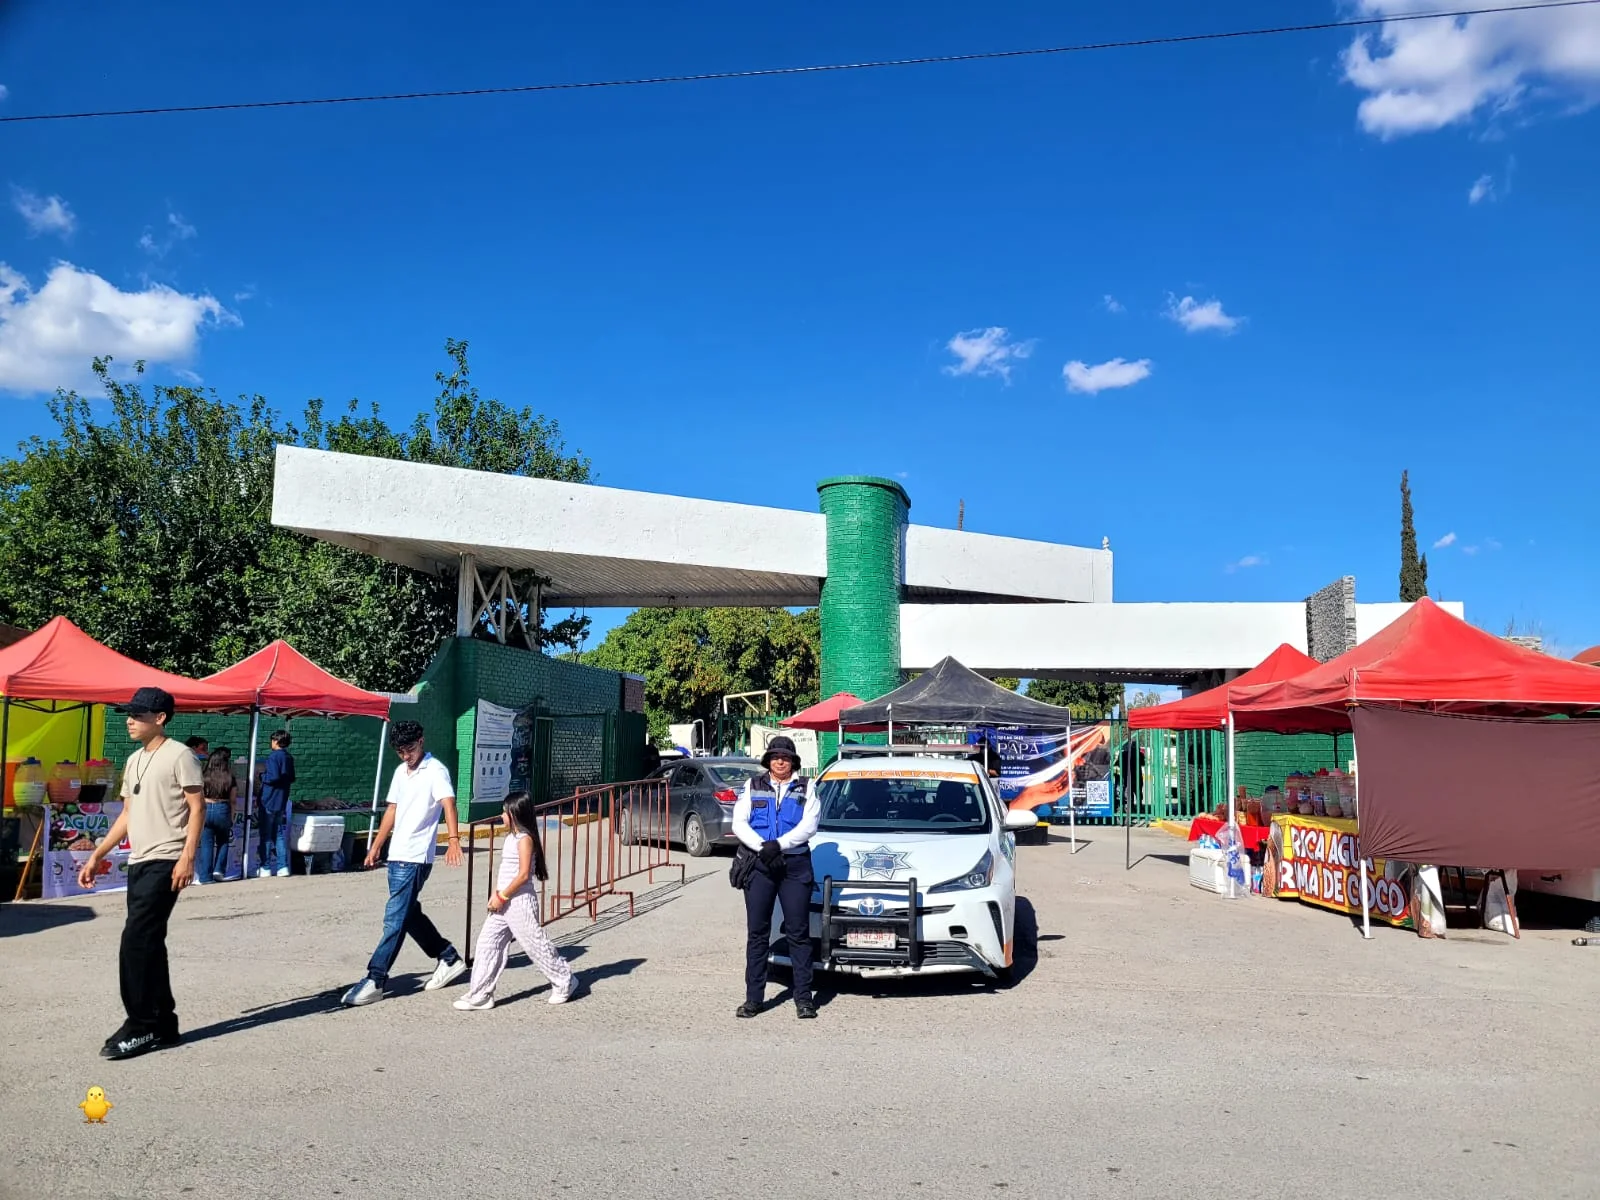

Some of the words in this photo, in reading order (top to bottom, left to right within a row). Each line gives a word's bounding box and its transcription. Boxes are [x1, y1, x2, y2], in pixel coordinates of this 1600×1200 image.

[63, 814, 109, 830] AGUA
[1291, 826, 1326, 862] RICA
[1328, 833, 1375, 872] AGU
[1323, 868, 1344, 903] DE
[1347, 874, 1405, 916] COCO
